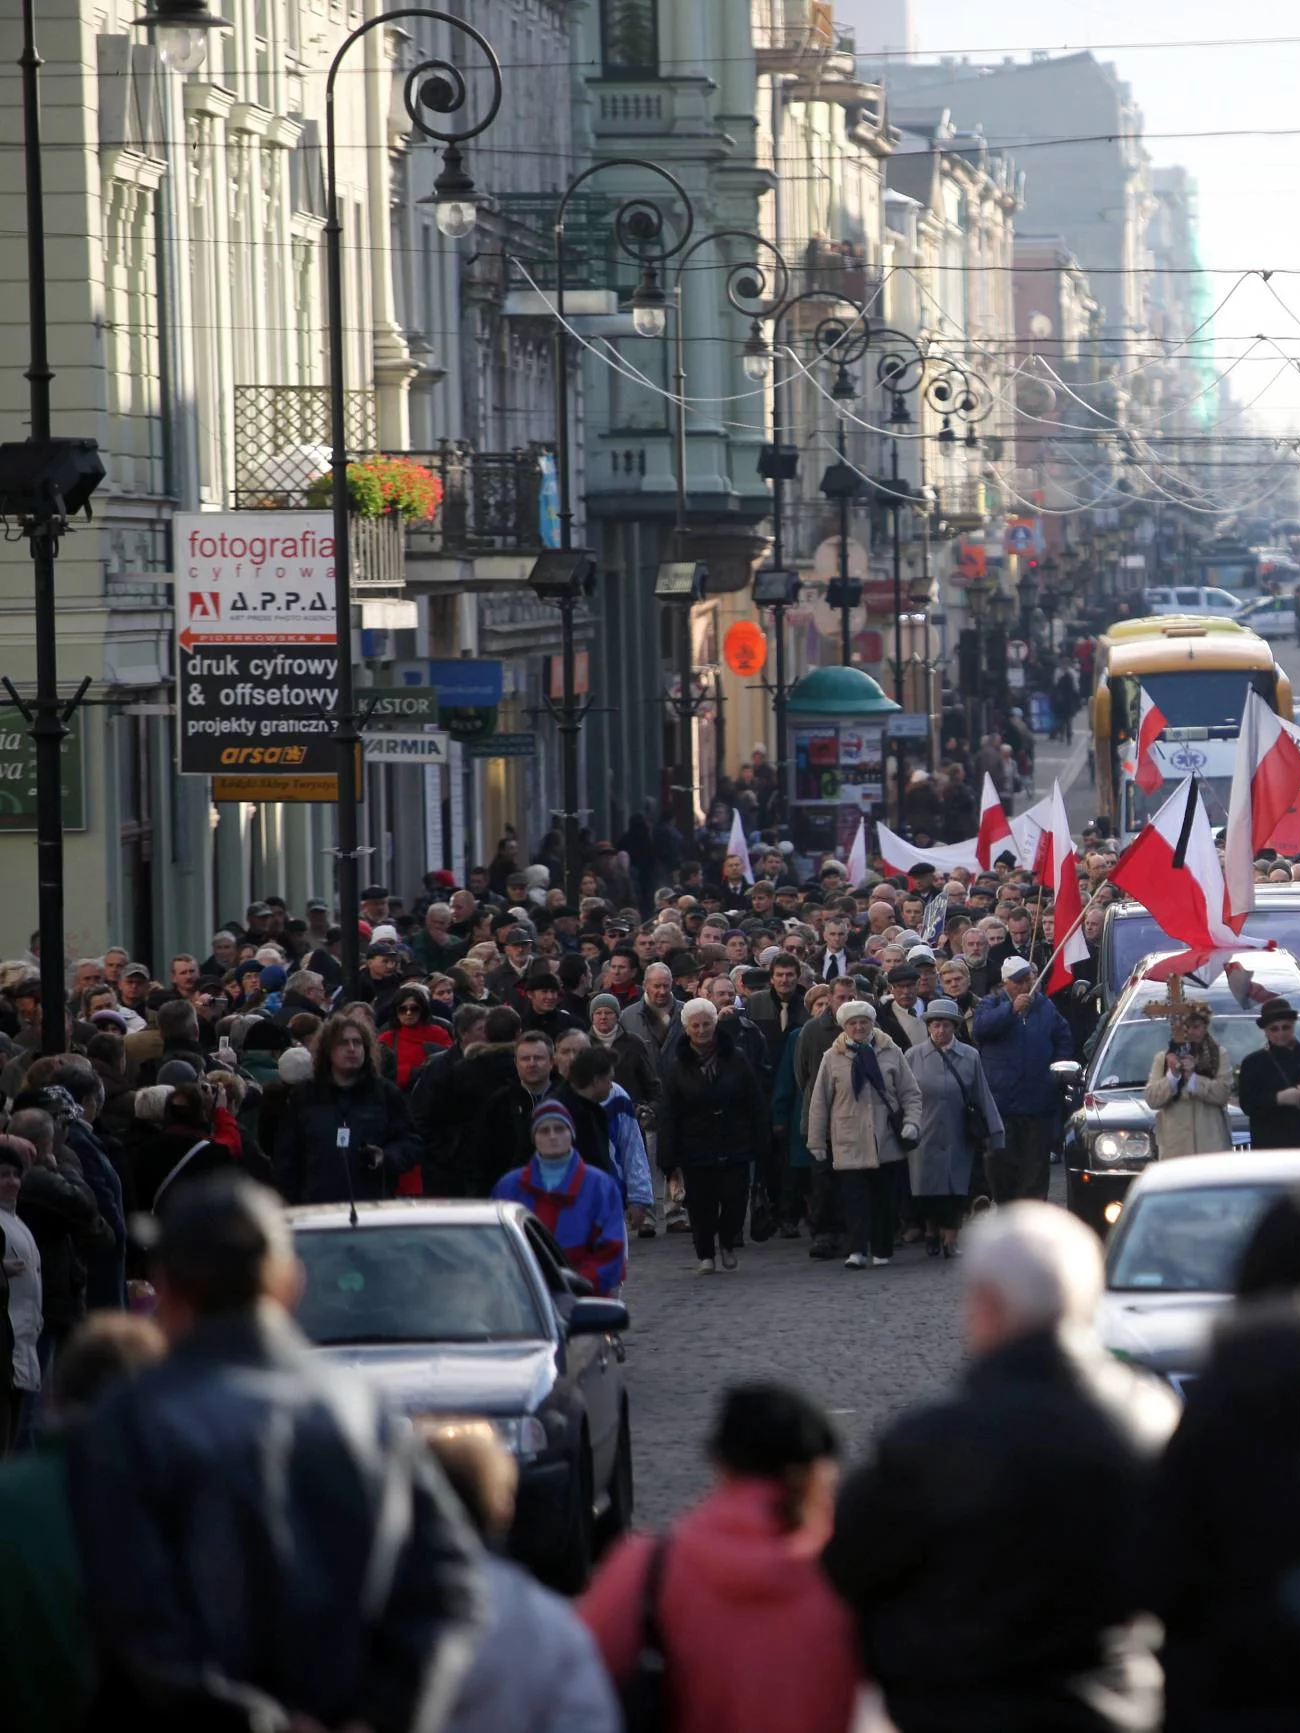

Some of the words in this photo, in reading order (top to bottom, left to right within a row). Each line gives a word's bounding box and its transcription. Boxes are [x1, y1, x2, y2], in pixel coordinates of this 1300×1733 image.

[188, 530, 337, 565] fotografia
[230, 591, 337, 612] A.P.P.A.
[199, 634, 307, 642] PIOTRKOWSKA
[187, 655, 240, 676] druk
[249, 654, 339, 680] cyfrowy
[187, 683, 206, 706] &
[219, 683, 339, 710] offsetowy
[358, 698, 431, 714] KASTOR
[187, 717, 257, 736] projekty
